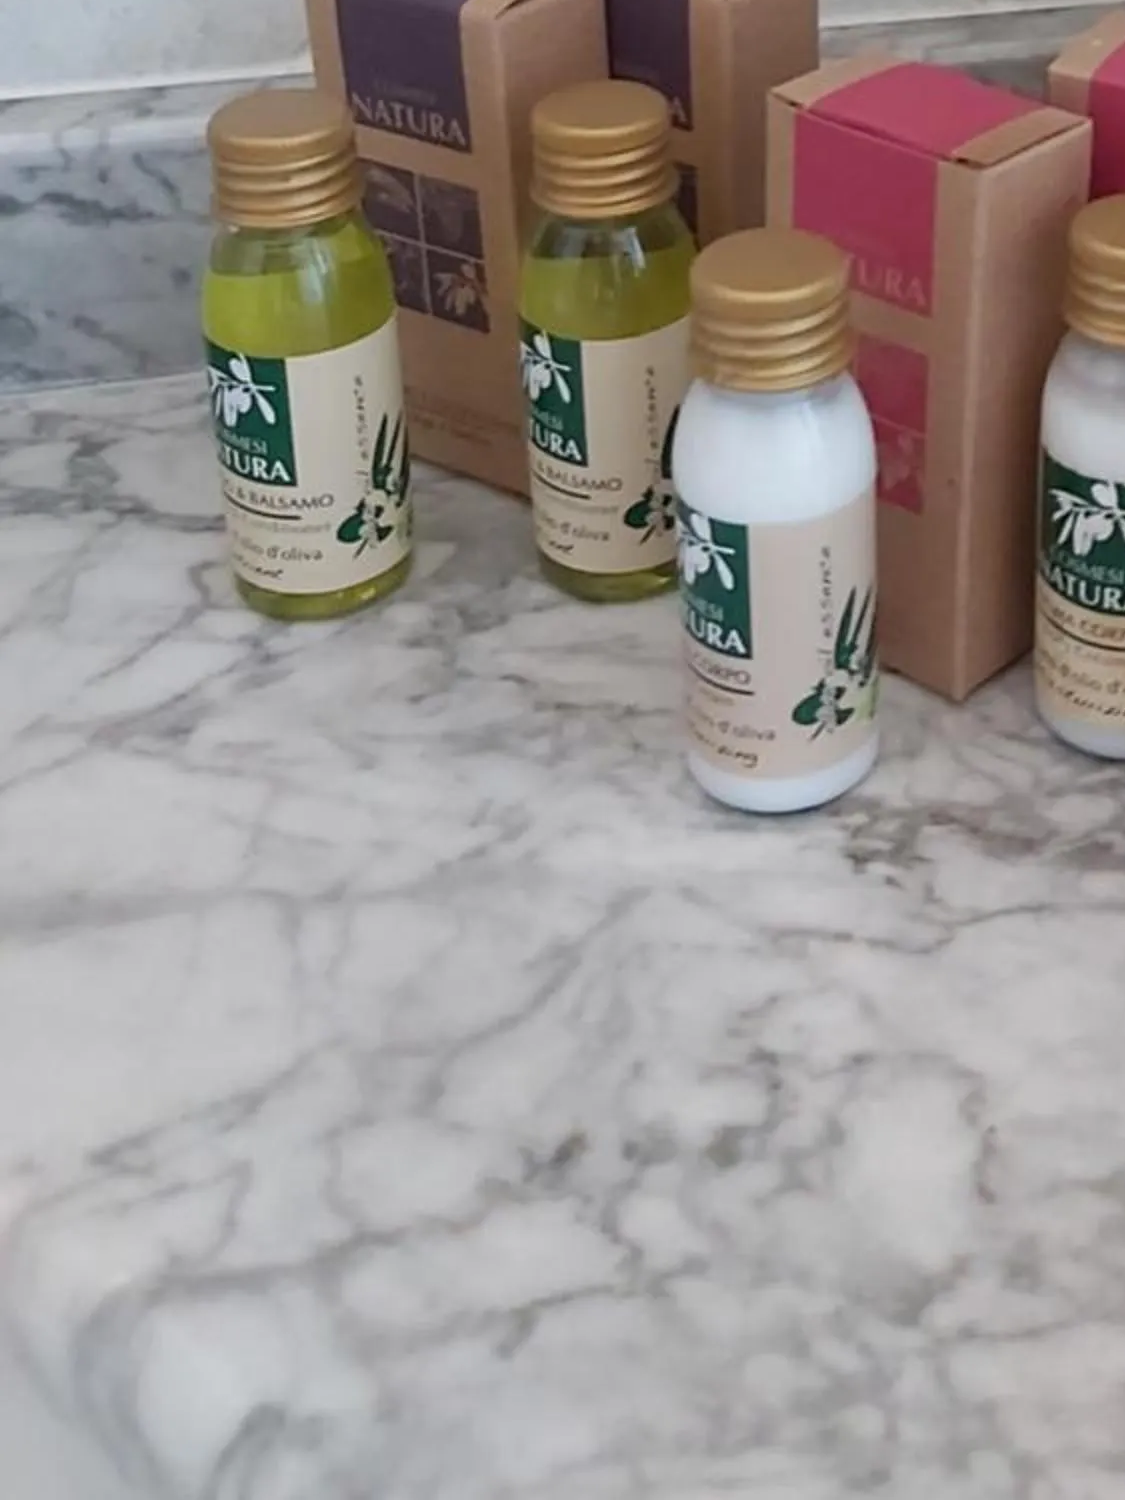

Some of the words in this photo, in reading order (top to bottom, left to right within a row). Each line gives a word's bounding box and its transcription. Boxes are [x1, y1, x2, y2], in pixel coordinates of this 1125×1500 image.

[352, 90, 467, 148] NATURA
[220, 443, 292, 482] TURA
[249, 491, 336, 511] BALSAMO
